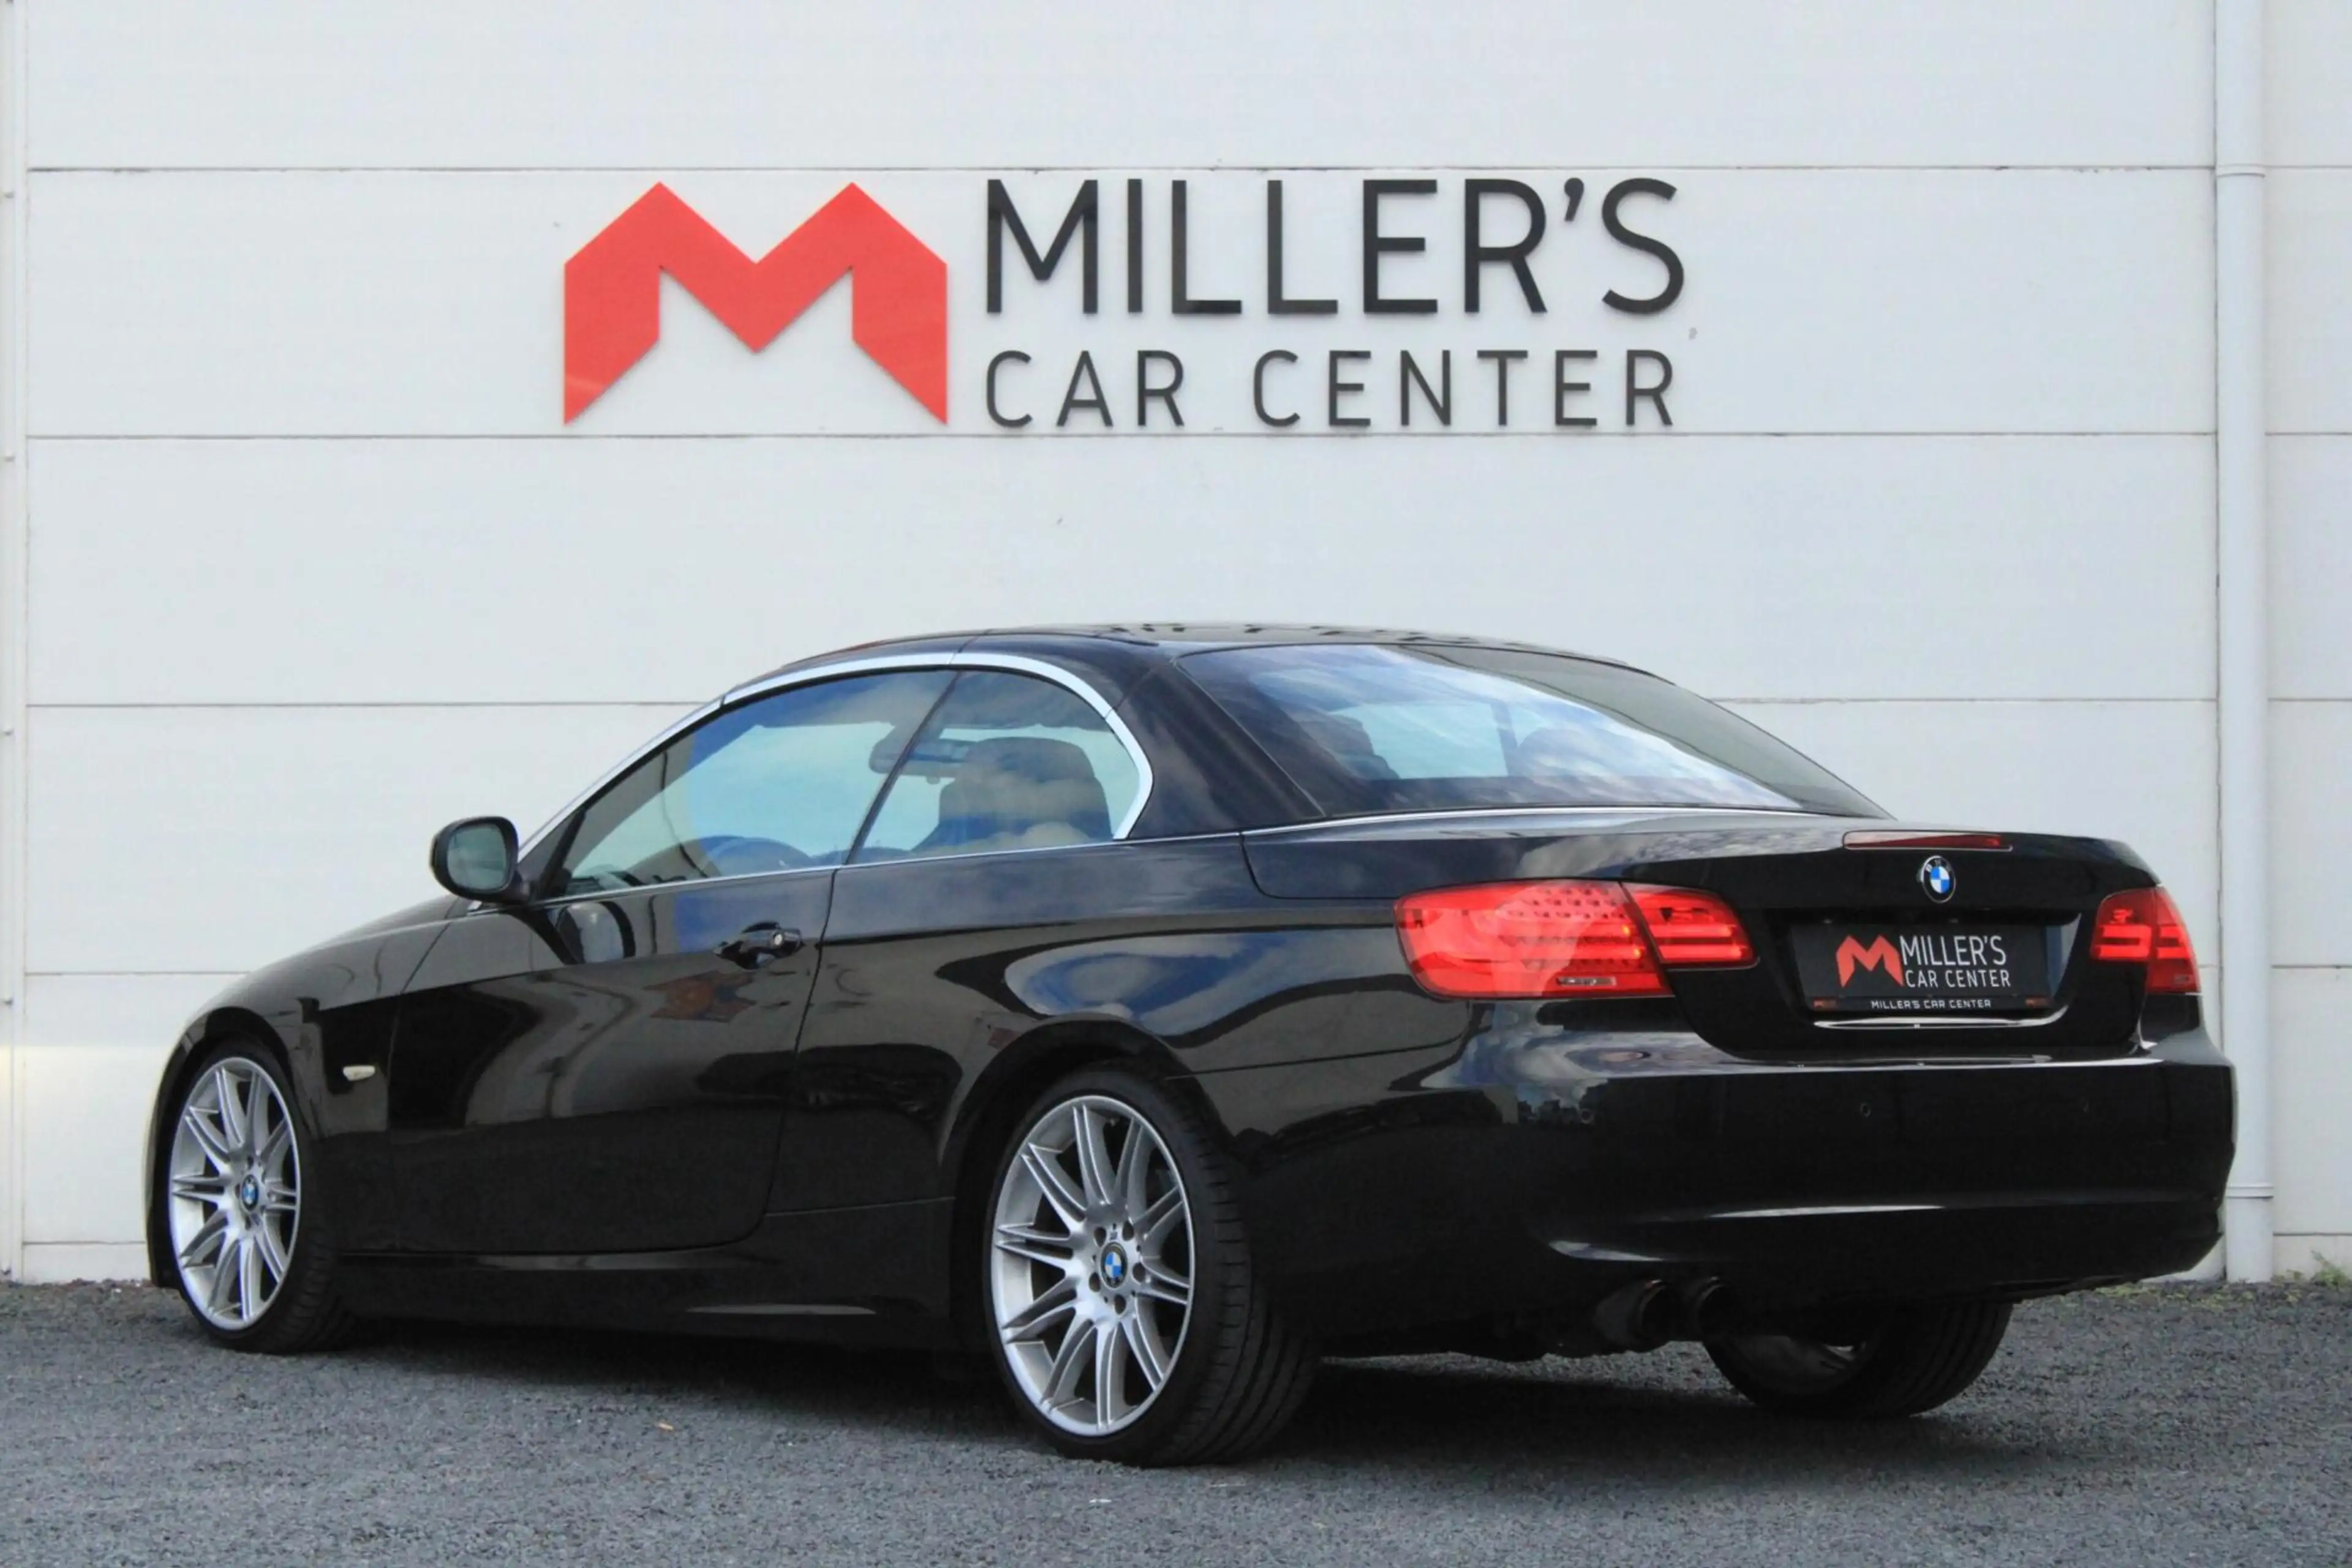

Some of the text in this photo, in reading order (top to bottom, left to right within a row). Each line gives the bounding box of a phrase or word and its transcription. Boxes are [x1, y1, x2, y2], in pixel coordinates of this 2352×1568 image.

[987, 178, 1684, 316] MILLER'S
[987, 350, 1674, 428] CAR CENTER
[1899, 935, 2007, 966] MILLER'S
[1905, 970, 2011, 988] CAR CENTER
[1923, 1000, 1946, 1009] CAR
[1949, 999, 1991, 1009] CENTER
